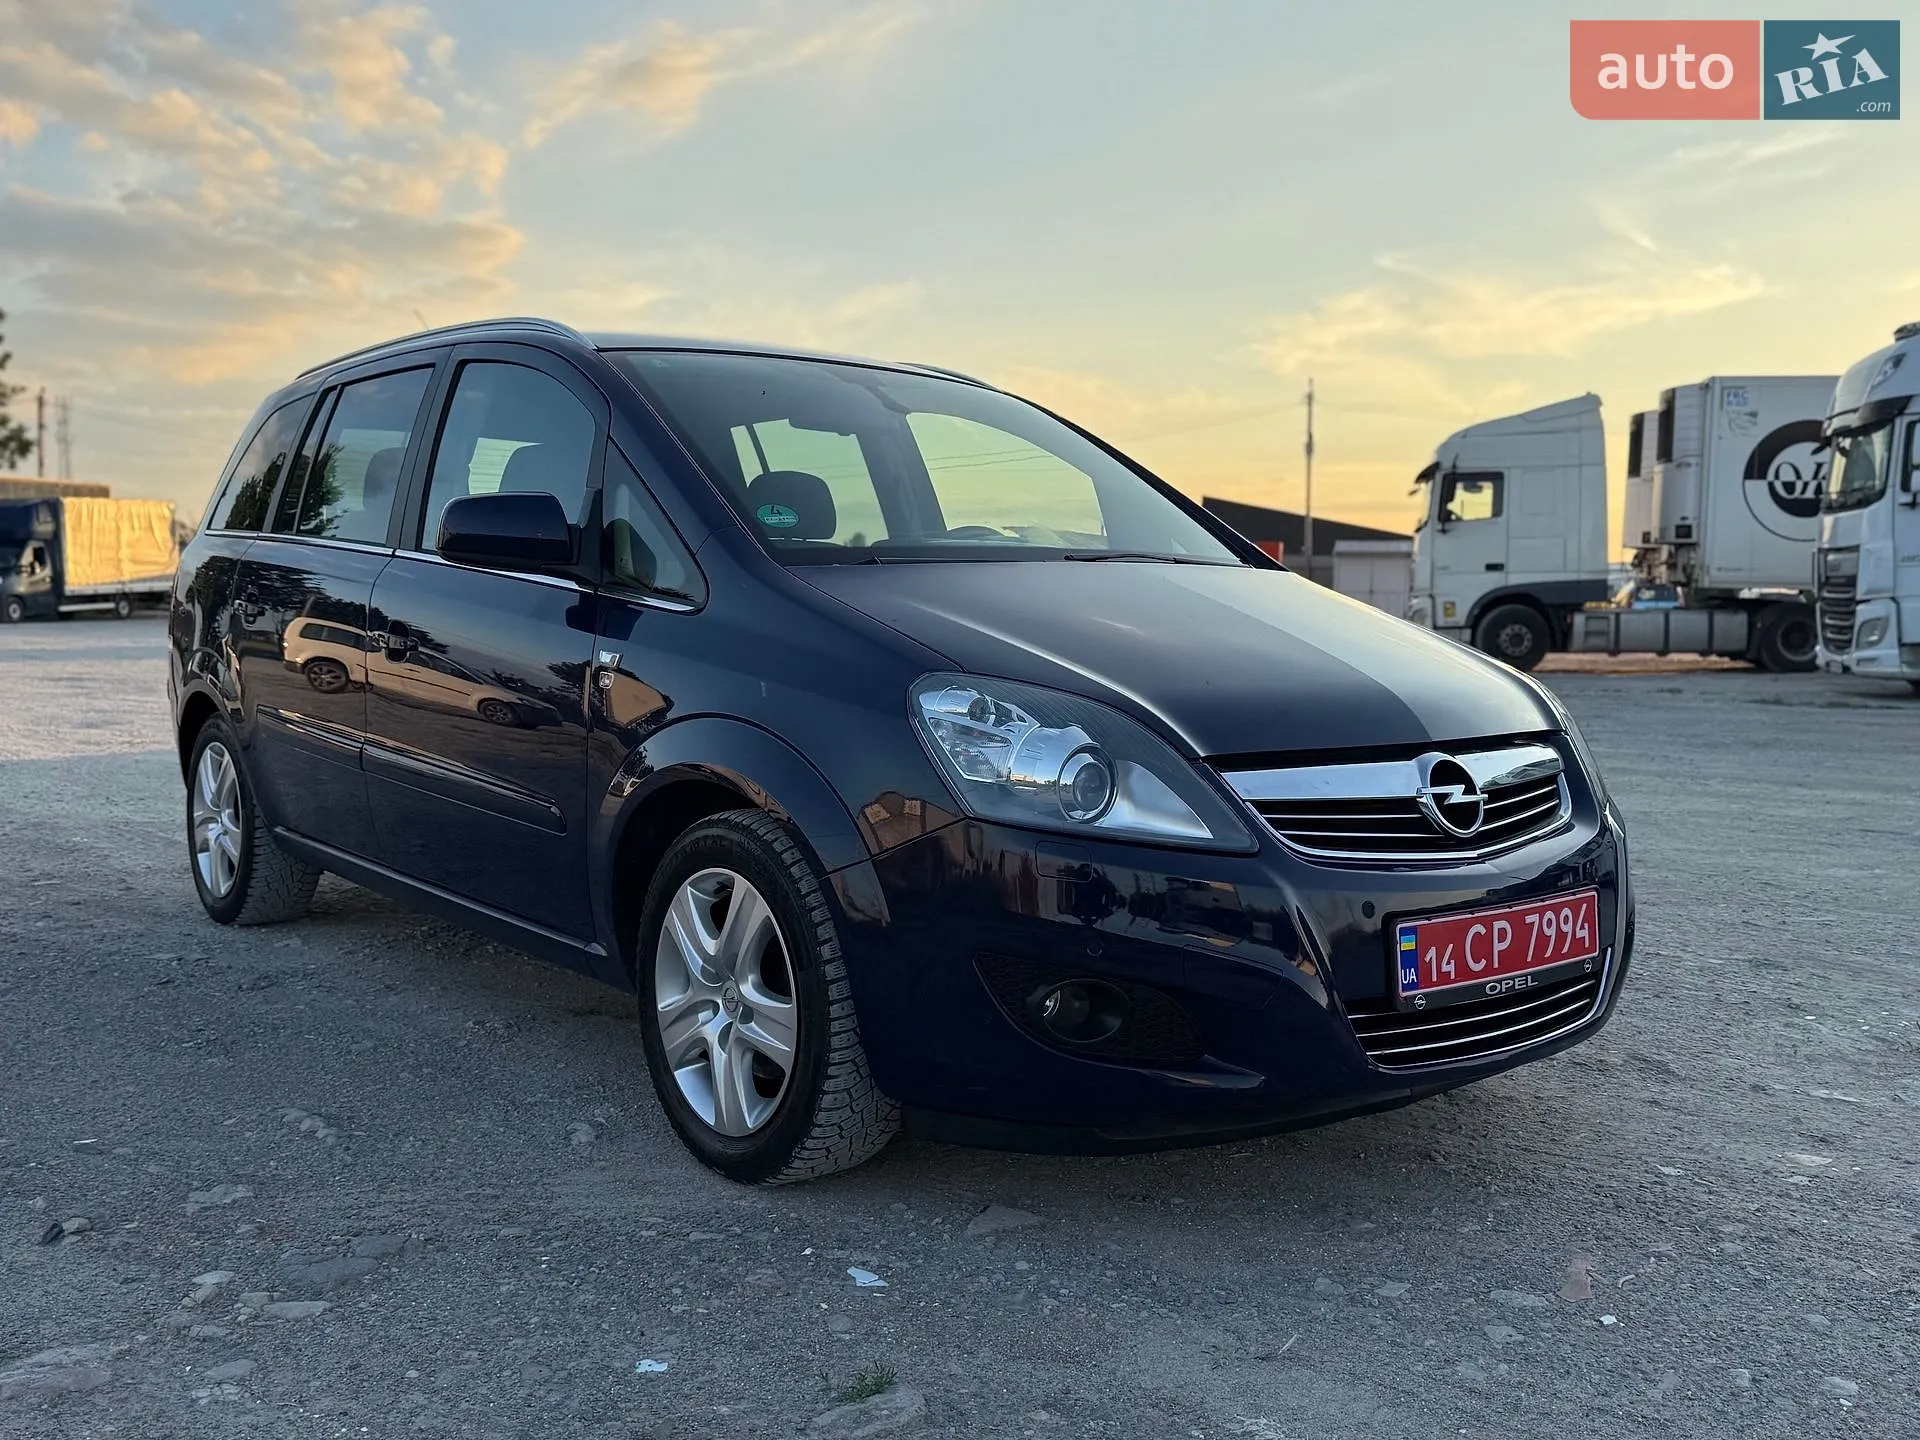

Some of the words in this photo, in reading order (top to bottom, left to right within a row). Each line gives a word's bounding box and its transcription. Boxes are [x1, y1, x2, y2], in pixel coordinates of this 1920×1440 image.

[1424, 943, 1456, 982] 14
[1464, 921, 1512, 972] CP
[1524, 903, 1590, 962] 7994
[1402, 968, 1417, 984] UA
[1485, 975, 1539, 995] OPEL
